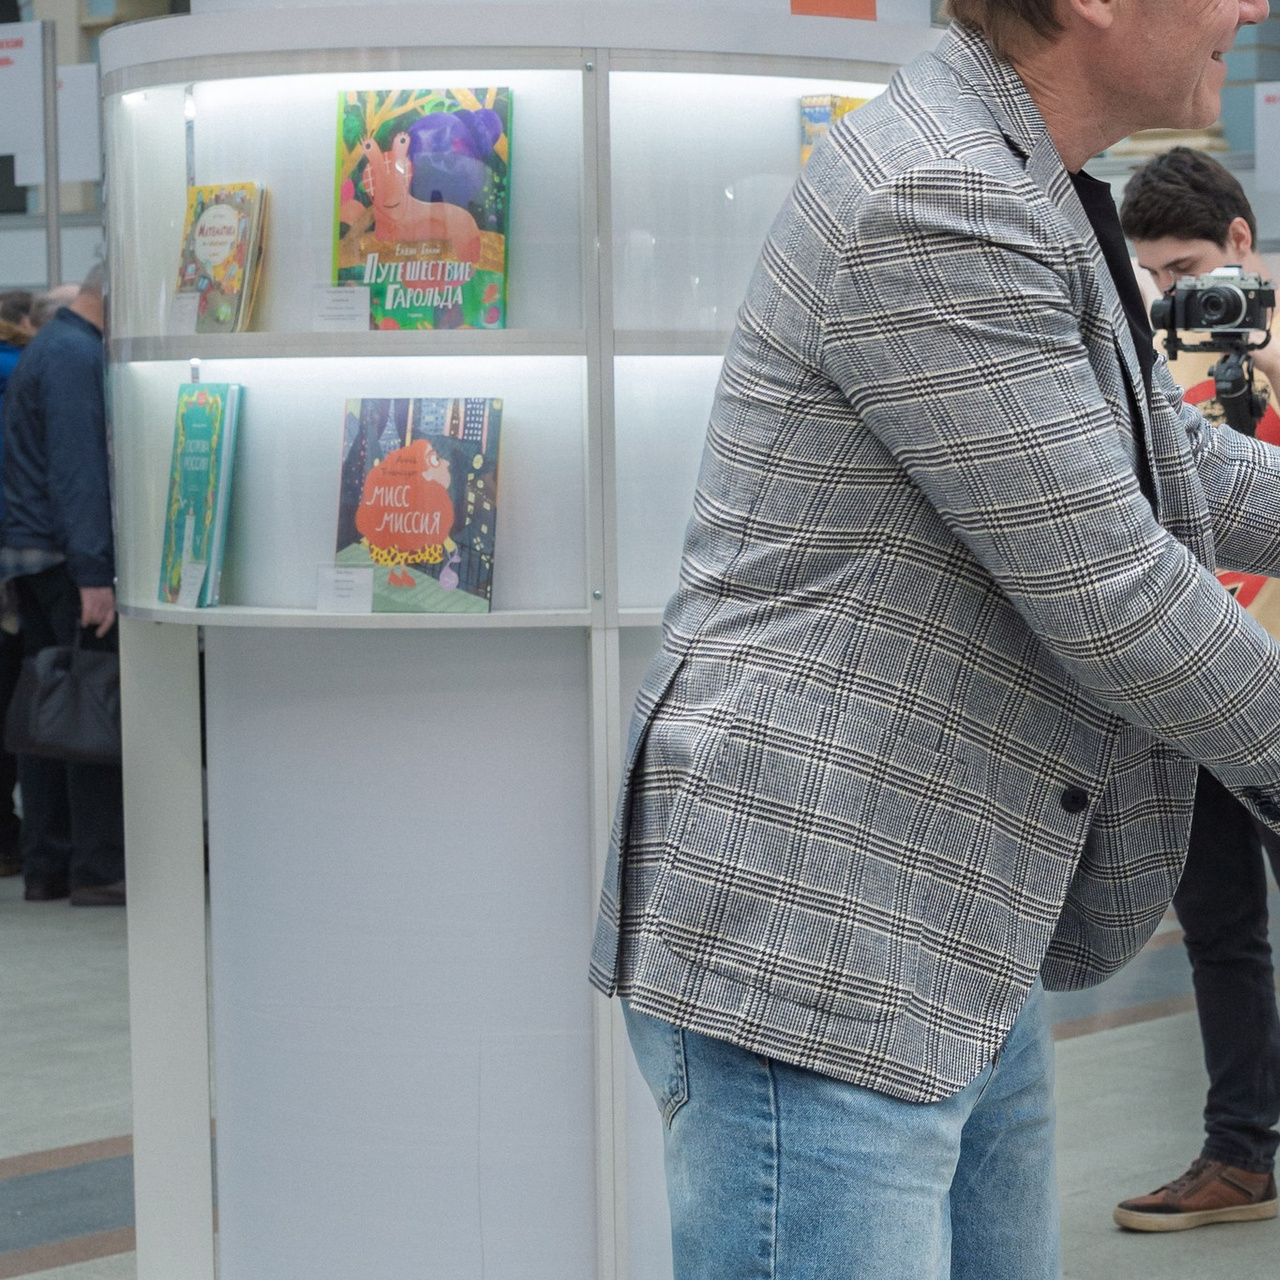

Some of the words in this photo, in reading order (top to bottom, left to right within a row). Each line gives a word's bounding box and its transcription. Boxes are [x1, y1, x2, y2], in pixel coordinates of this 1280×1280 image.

[385, 284, 463, 310] ГАРОЛЬДА
[366, 485, 411, 507] МИСС
[375, 511, 441, 535] МИССИЯ
